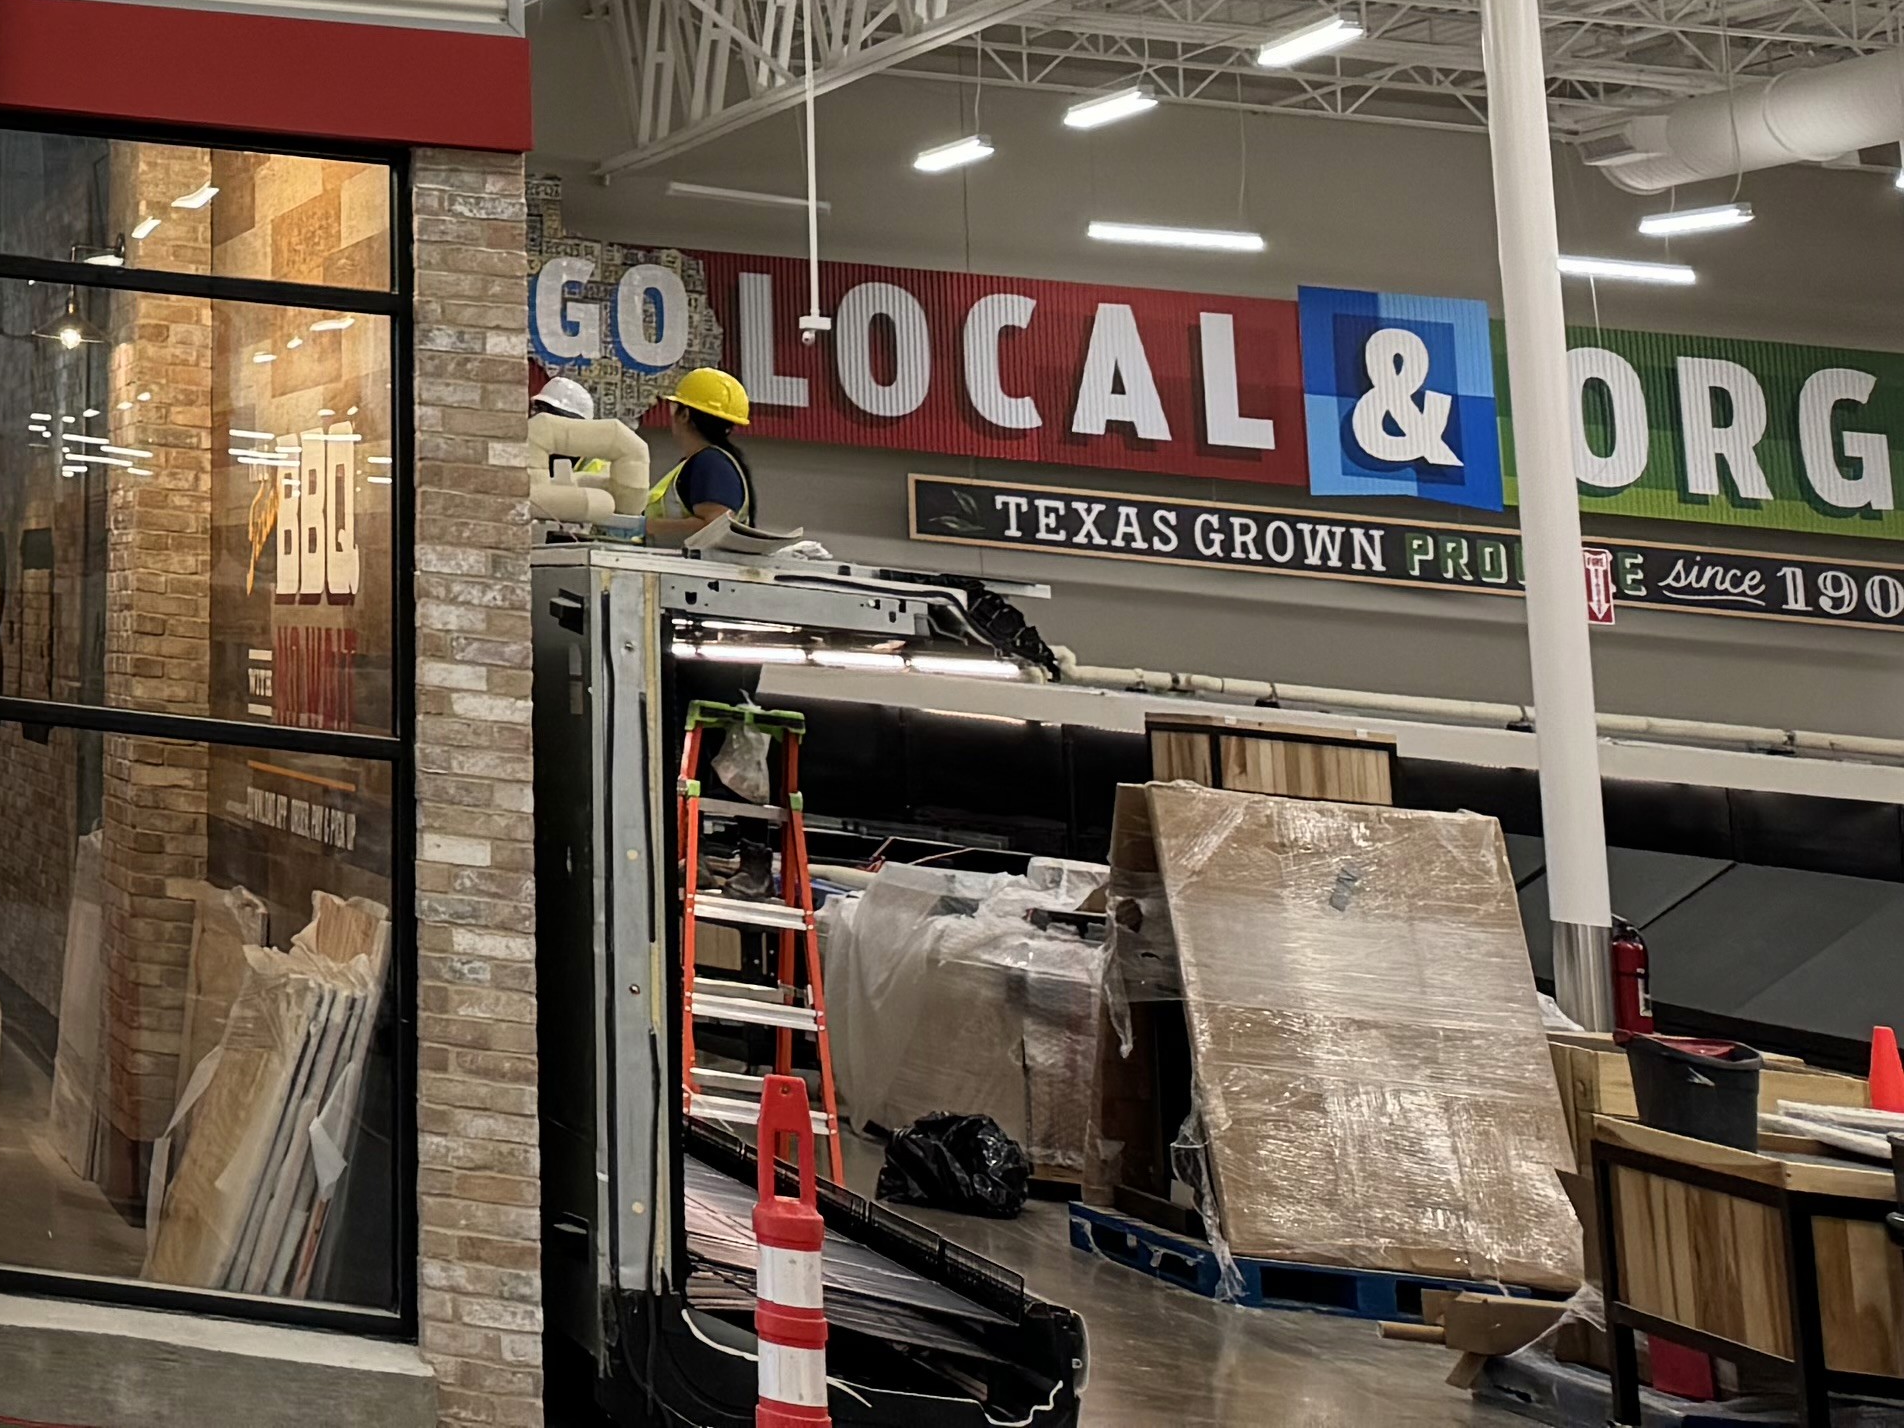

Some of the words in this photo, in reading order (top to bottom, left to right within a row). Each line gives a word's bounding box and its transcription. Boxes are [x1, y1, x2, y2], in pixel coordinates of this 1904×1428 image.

[535, 256, 689, 367] GO
[738, 271, 1275, 450] LOCAL
[1352, 327, 1464, 467] &
[1565, 347, 1895, 511] ORG
[276, 420, 359, 595] BBQ
[995, 494, 1179, 553] TEXAS
[1194, 513, 1386, 572] GROWN
[1658, 555, 1766, 597] since
[1777, 566, 1904, 618] 190
